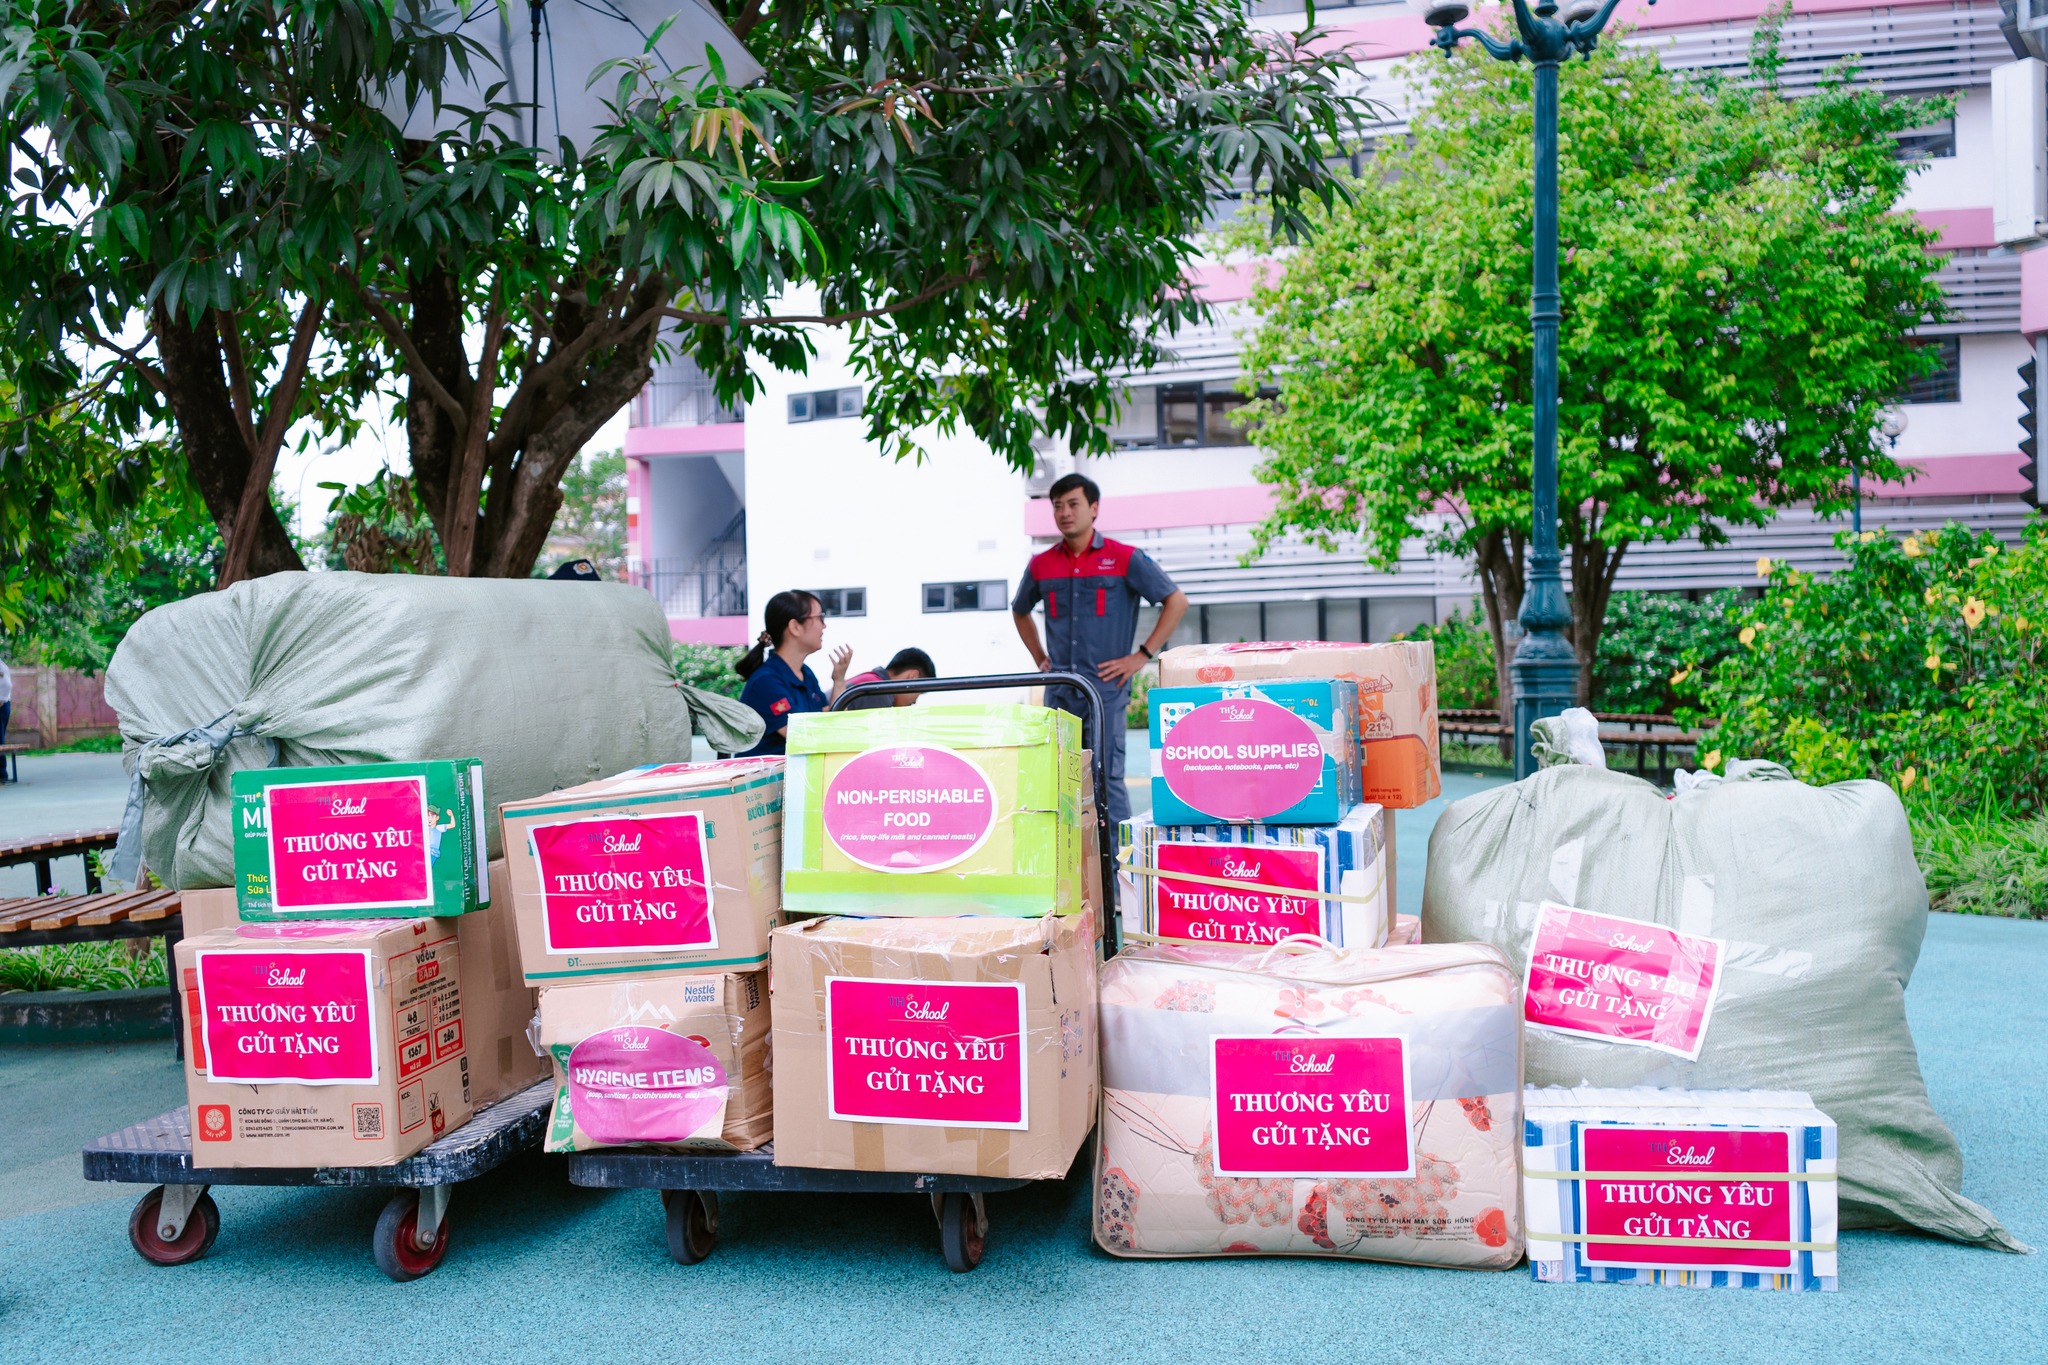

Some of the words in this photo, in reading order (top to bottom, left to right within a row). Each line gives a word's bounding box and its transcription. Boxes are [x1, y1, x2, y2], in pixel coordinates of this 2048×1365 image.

[1361, 679, 1380, 690] 100%
[1229, 708, 1255, 720] School
[1368, 722, 1389, 732] 21%
[1165, 745, 1233, 761] SCHOOL
[1237, 743, 1320, 759] SUPPLIES
[1183, 764, 1223, 772] (backpacks,
[1225, 763, 1262, 771] notebooks,
[1264, 763, 1283, 771] pens,
[1285, 762, 1299, 770] etc)
[317, 797, 331, 806] TH
[331, 797, 367, 815] School
[837, 788, 985, 805] NON-PERISHABLE
[243, 807, 268, 829] MI
[884, 812, 931, 827] FOOD
[284, 832, 367, 853] THƯƠNG
[372, 827, 412, 848] YÊU
[603, 833, 642, 853] School
[860, 833, 889, 841] long-life
[951, 833, 976, 841] meats)
[302, 859, 338, 882] GỬI
[342, 858, 397, 883] TẶNG
[1209, 857, 1223, 866] TH
[1222, 862, 1261, 878] School
[247, 873, 268, 883] Thức
[555, 871, 644, 892] THƯƠNG
[648, 865, 692, 888] YÊU
[247, 885, 264, 894] Sữa
[576, 899, 615, 923] GỬI
[618, 899, 678, 925] TẶNG
[1169, 892, 1260, 913] THƯƠNG
[1265, 894, 1307, 916] YÊU
[1188, 919, 1225, 939] GỬI
[1231, 921, 1290, 944] TẶNG
[1609, 932, 1654, 954] School
[252, 966, 267, 974] TH
[268, 968, 306, 986] School
[419, 965, 437, 980] BABY
[1545, 954, 1642, 987] THƯƠNG
[1648, 974, 1695, 997] YÊU
[685, 984, 715, 995] Nestlé
[685, 995, 715, 1003] Waters
[217, 1003, 307, 1023] THƯƠNG
[311, 1001, 356, 1023] YÊU
[887, 996, 905, 1007] TH
[904, 1001, 950, 1020] School
[1559, 986, 1603, 1010] GỬI
[1605, 994, 1668, 1020] TẶNG
[407, 1011, 417, 1024] 48
[238, 1030, 276, 1054] GỬI
[280, 1032, 340, 1058] TẶNG
[408, 1044, 421, 1059] 1367
[613, 1034, 623, 1043] TH
[623, 1036, 650, 1050] School
[845, 1036, 948, 1060] THƯƠNG
[954, 1038, 1005, 1060] YÊU
[1273, 1051, 1291, 1060] TH
[1290, 1054, 1335, 1073] School
[575, 1067, 648, 1088] HYGIENE
[653, 1066, 716, 1087] ITEMS
[866, 1067, 910, 1091] GỬI
[915, 1070, 984, 1098] TẶNG
[586, 1091, 604, 1100] (soap,
[604, 1092, 630, 1100] sanitizer,
[632, 1091, 683, 1100] toothbrushes,
[1230, 1091, 1335, 1113] THƯƠNG
[1339, 1089, 1390, 1113] YÊU
[205, 1129, 214, 1138] HẢI
[215, 1129, 226, 1138] TIẾN
[1252, 1121, 1297, 1146] GỬI
[1302, 1122, 1371, 1150] TẶNG
[1667, 1146, 1715, 1165] School
[1601, 1182, 1712, 1205] THƯƠNG
[1719, 1181, 1773, 1206] YÊU
[1623, 1212, 1672, 1236] GỬI
[1678, 1214, 1751, 1239] TẶNG
